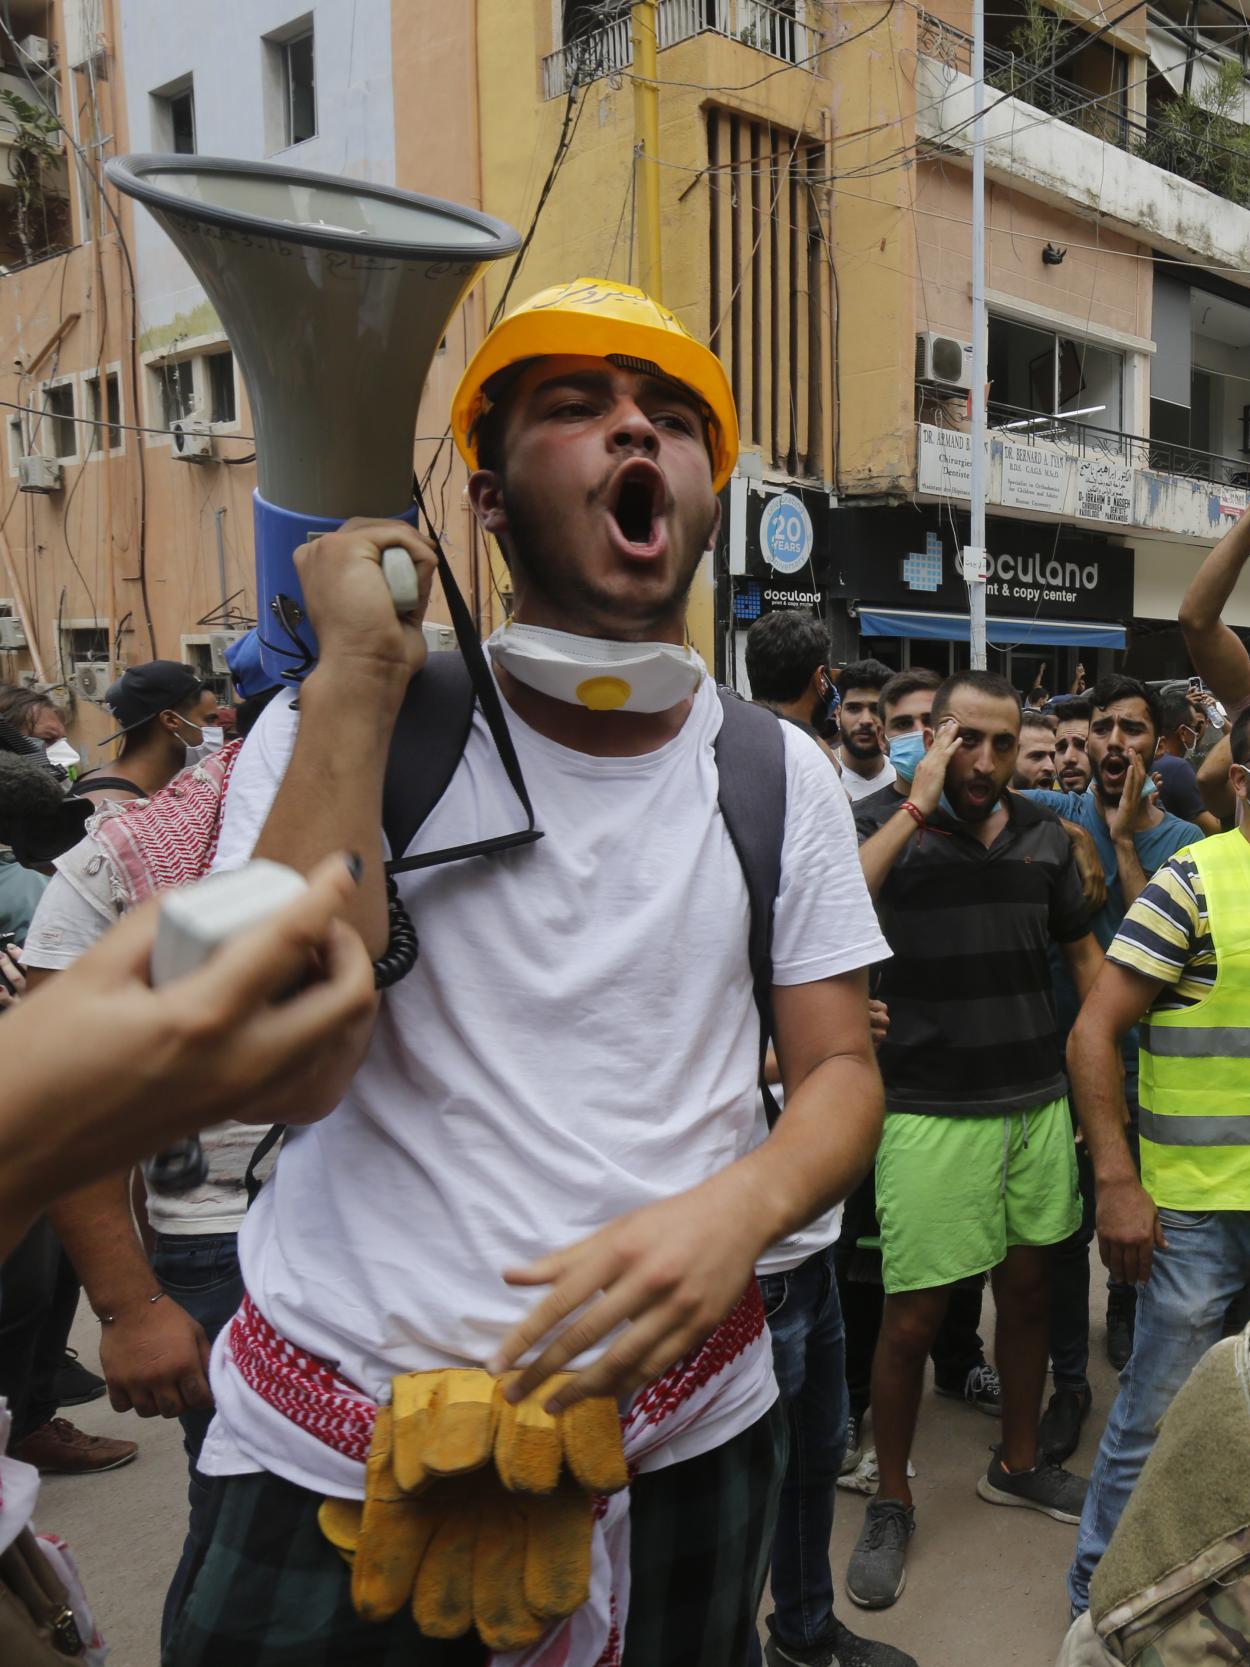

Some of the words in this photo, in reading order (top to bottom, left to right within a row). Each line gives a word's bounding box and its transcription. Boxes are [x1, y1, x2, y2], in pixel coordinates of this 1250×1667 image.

[923, 429, 935, 444] DR.
[937, 431, 964, 450] ARMAND
[1016, 448, 1042, 465] BERNARD
[943, 467, 970, 479] Dentiste
[772, 514, 801, 542] 20
[772, 538, 800, 553] YEARS
[763, 589, 821, 603] doculand
[1002, 583, 1010, 596] &
[1013, 588, 1040, 602] copy
[1043, 590, 1077, 602] center
